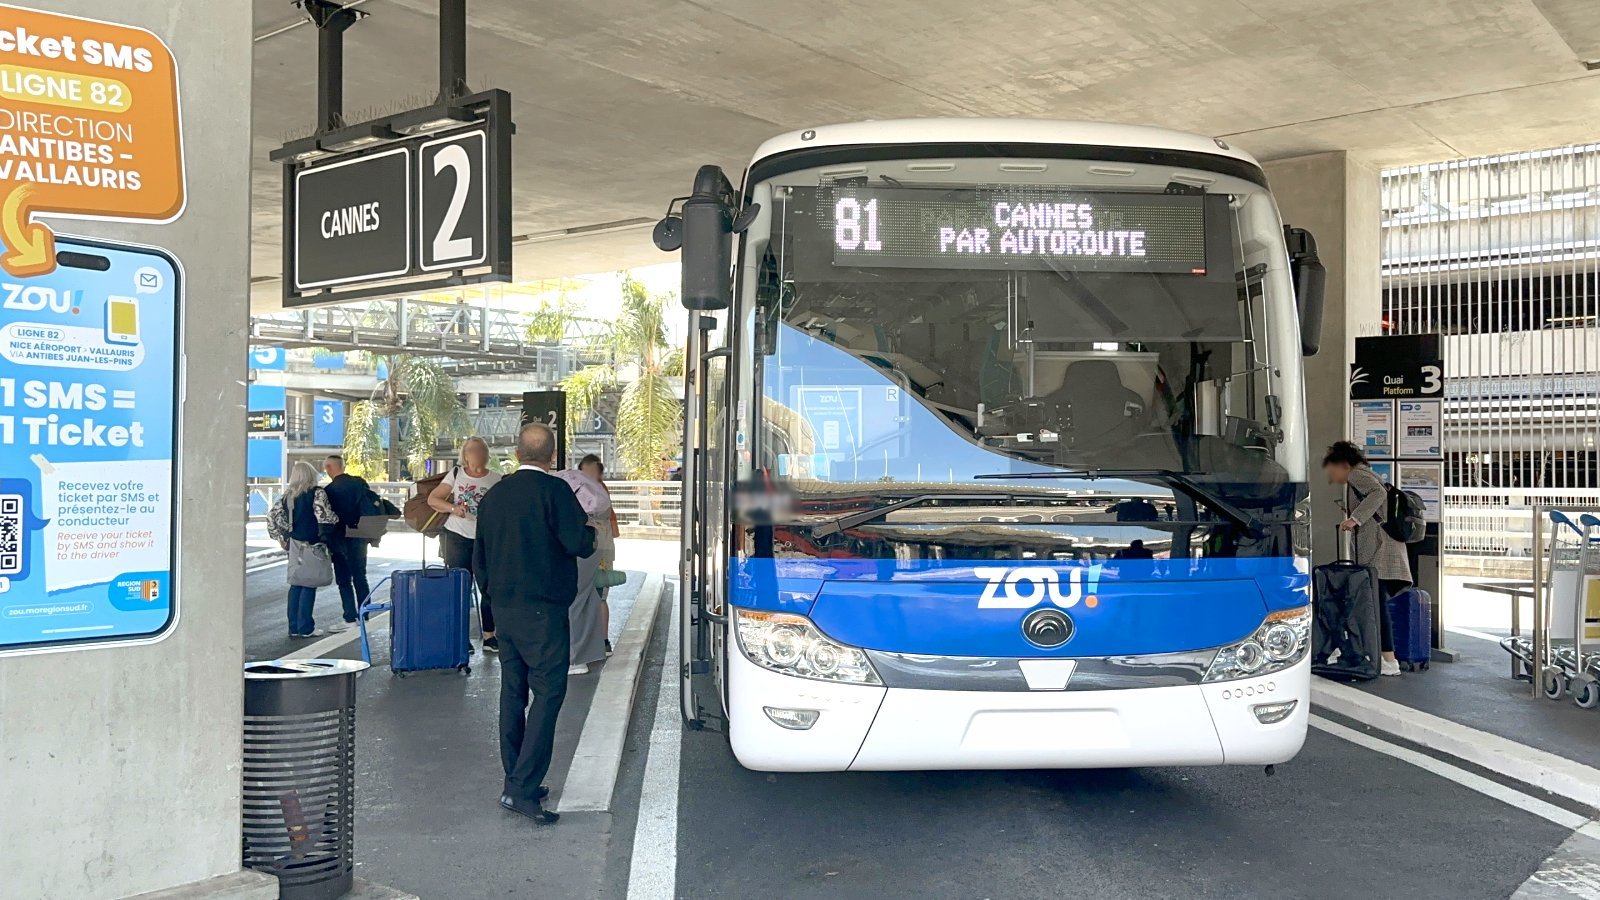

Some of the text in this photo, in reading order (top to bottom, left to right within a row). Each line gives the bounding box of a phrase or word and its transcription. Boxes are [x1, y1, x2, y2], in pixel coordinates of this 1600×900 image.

[82, 39, 154, 73] SMS
[1, 70, 124, 107] LIGNE 82
[0, 109, 133, 144] DIRECTION
[0, 134, 114, 165] ANTIBES
[0, 160, 141, 191] VALLAURIS
[433, 144, 473, 262] 2
[321, 202, 380, 239] CANNES
[836, 198, 882, 251] 81
[995, 202, 1093, 229] CANNES
[940, 227, 1146, 256] PAR AUTOROUTE
[17, 328, 60, 340] LIGNE 82
[9, 350, 133, 366] VIA ANTIBES JUAN-LES-PINS
[10, 341, 32, 350] NICE
[33, 341, 82, 354] AÉROPORT
[89, 347, 135, 358] VALLAURIS
[1383, 375, 1404, 385] Quai
[1420, 365, 1442, 394] 3
[0, 378, 15, 408] 1
[23, 380, 107, 411] SMS
[887, 388, 897, 400] R
[1383, 386, 1414, 395] Platform
[322, 405, 334, 424] 3
[548, 411, 557, 428] 2
[0, 413, 144, 447] 1 Ticket
[58, 480, 144, 491] Recevez votre
[58, 492, 160, 505] ticket par SMS et
[58, 504, 155, 517] présentez-le au
[58, 516, 130, 526] conducteur
[57, 530, 153, 542] Receive your ticket
[57, 539, 154, 551] by SMS and show it
[57, 550, 120, 561] to the driver
[973, 563, 1103, 609] ZOU!
